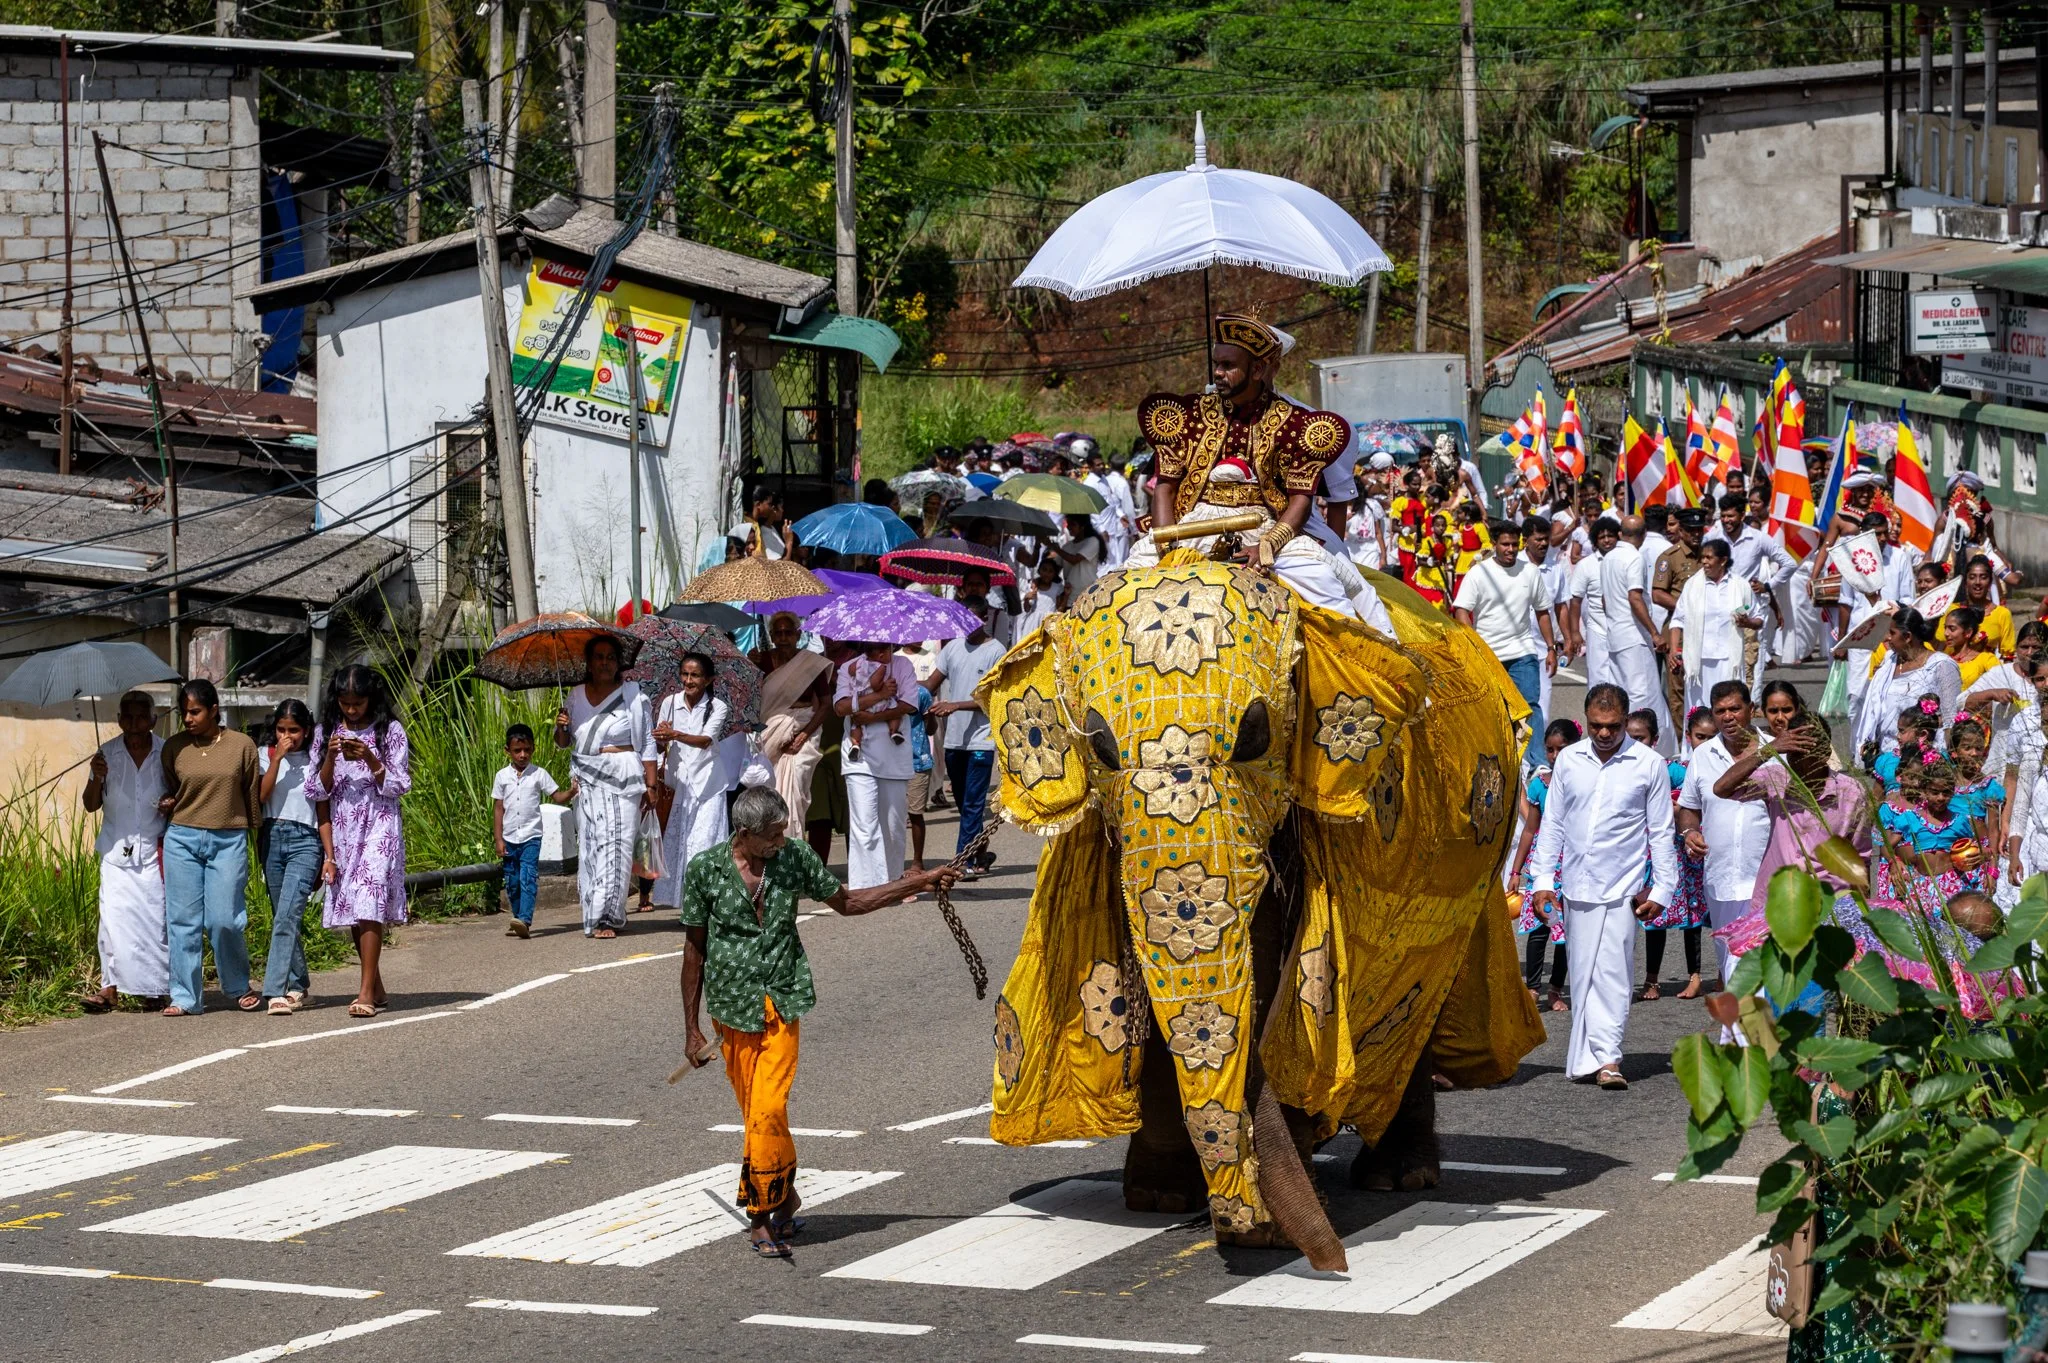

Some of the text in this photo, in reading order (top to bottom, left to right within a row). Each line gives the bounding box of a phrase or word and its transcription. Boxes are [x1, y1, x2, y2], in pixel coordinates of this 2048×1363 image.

[547, 262, 612, 287] Malin
[1922, 307, 1990, 319] MEDICAL CENTER
[1953, 319, 1980, 327] LASANTHA
[2010, 332, 2047, 358] CENTRE
